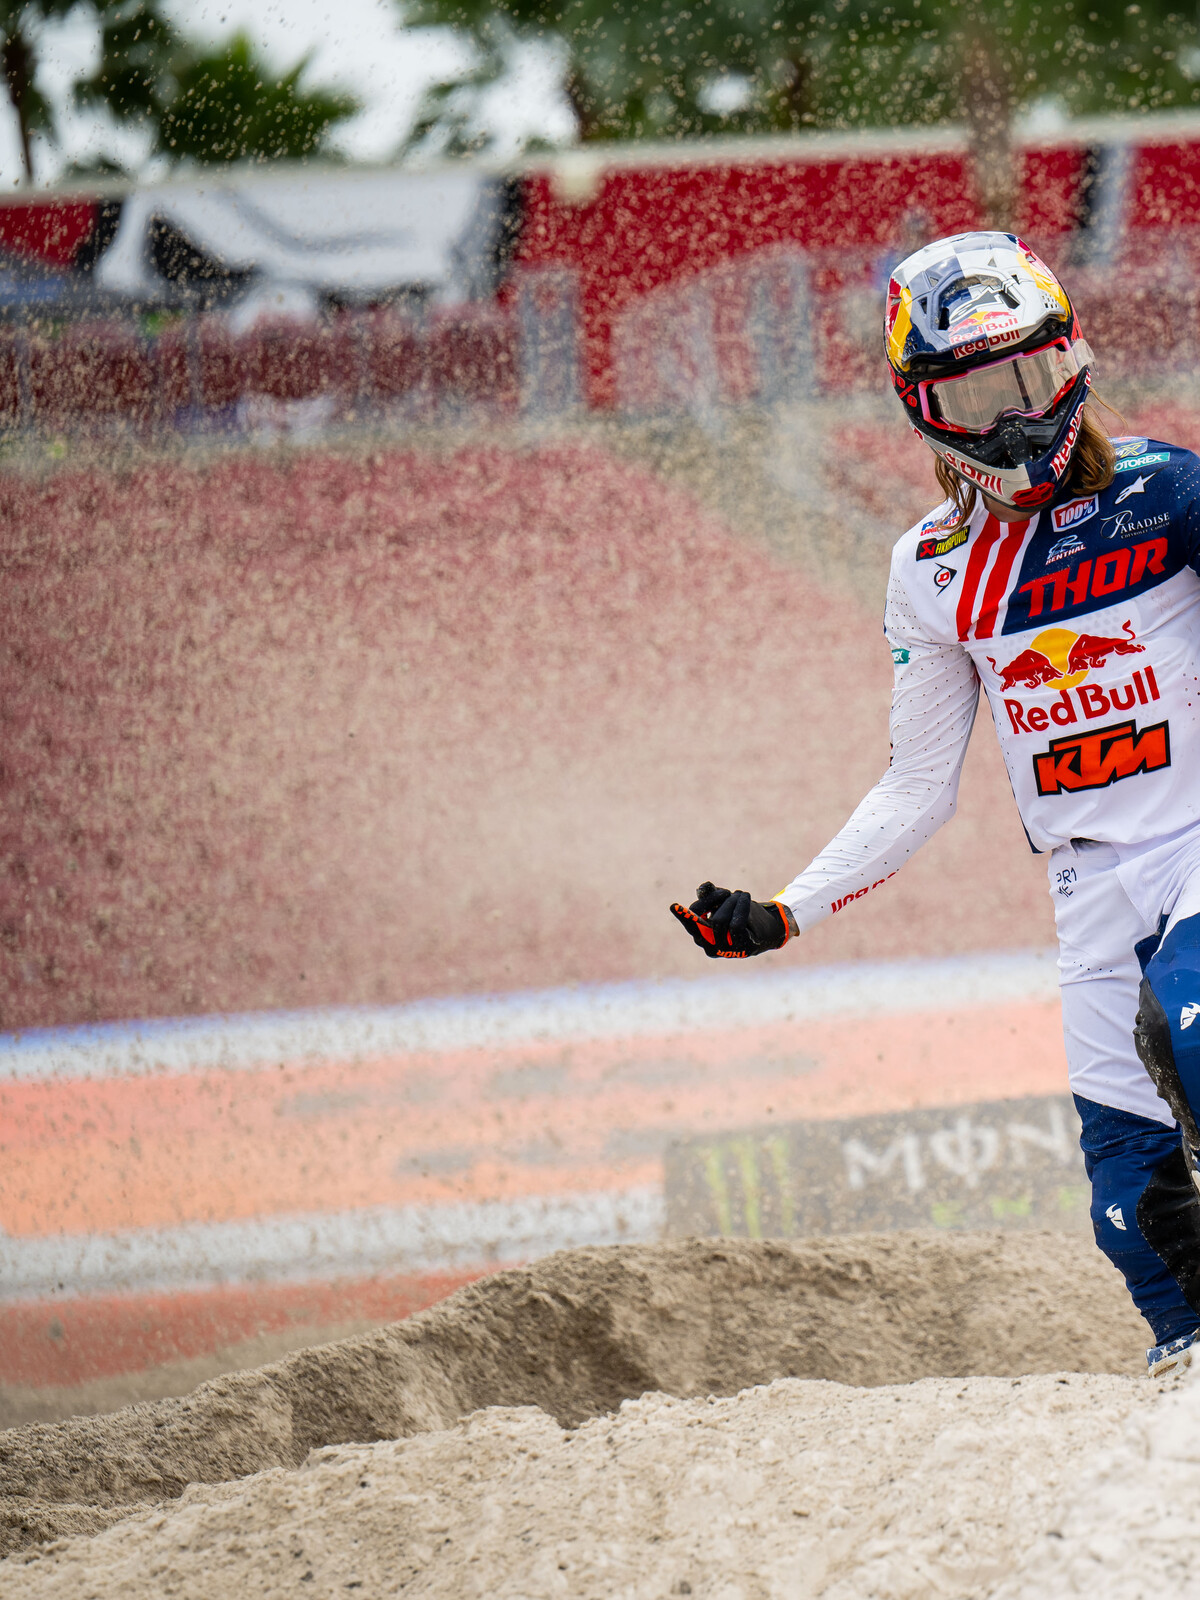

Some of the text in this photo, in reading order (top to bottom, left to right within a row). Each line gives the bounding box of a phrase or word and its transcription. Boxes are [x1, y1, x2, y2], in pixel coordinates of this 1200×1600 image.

[950, 317, 1019, 344] Red Bull
[953, 338, 989, 360] Red
[1113, 454, 1163, 471] OTOREX
[1059, 499, 1095, 527] 100%
[1100, 509, 1171, 539] PARADISE
[1045, 544, 1087, 566] RENTHAL
[1018, 536, 1169, 618] THOR
[1003, 665, 1161, 735] Red Bull
[1033, 719, 1171, 796] KTM
